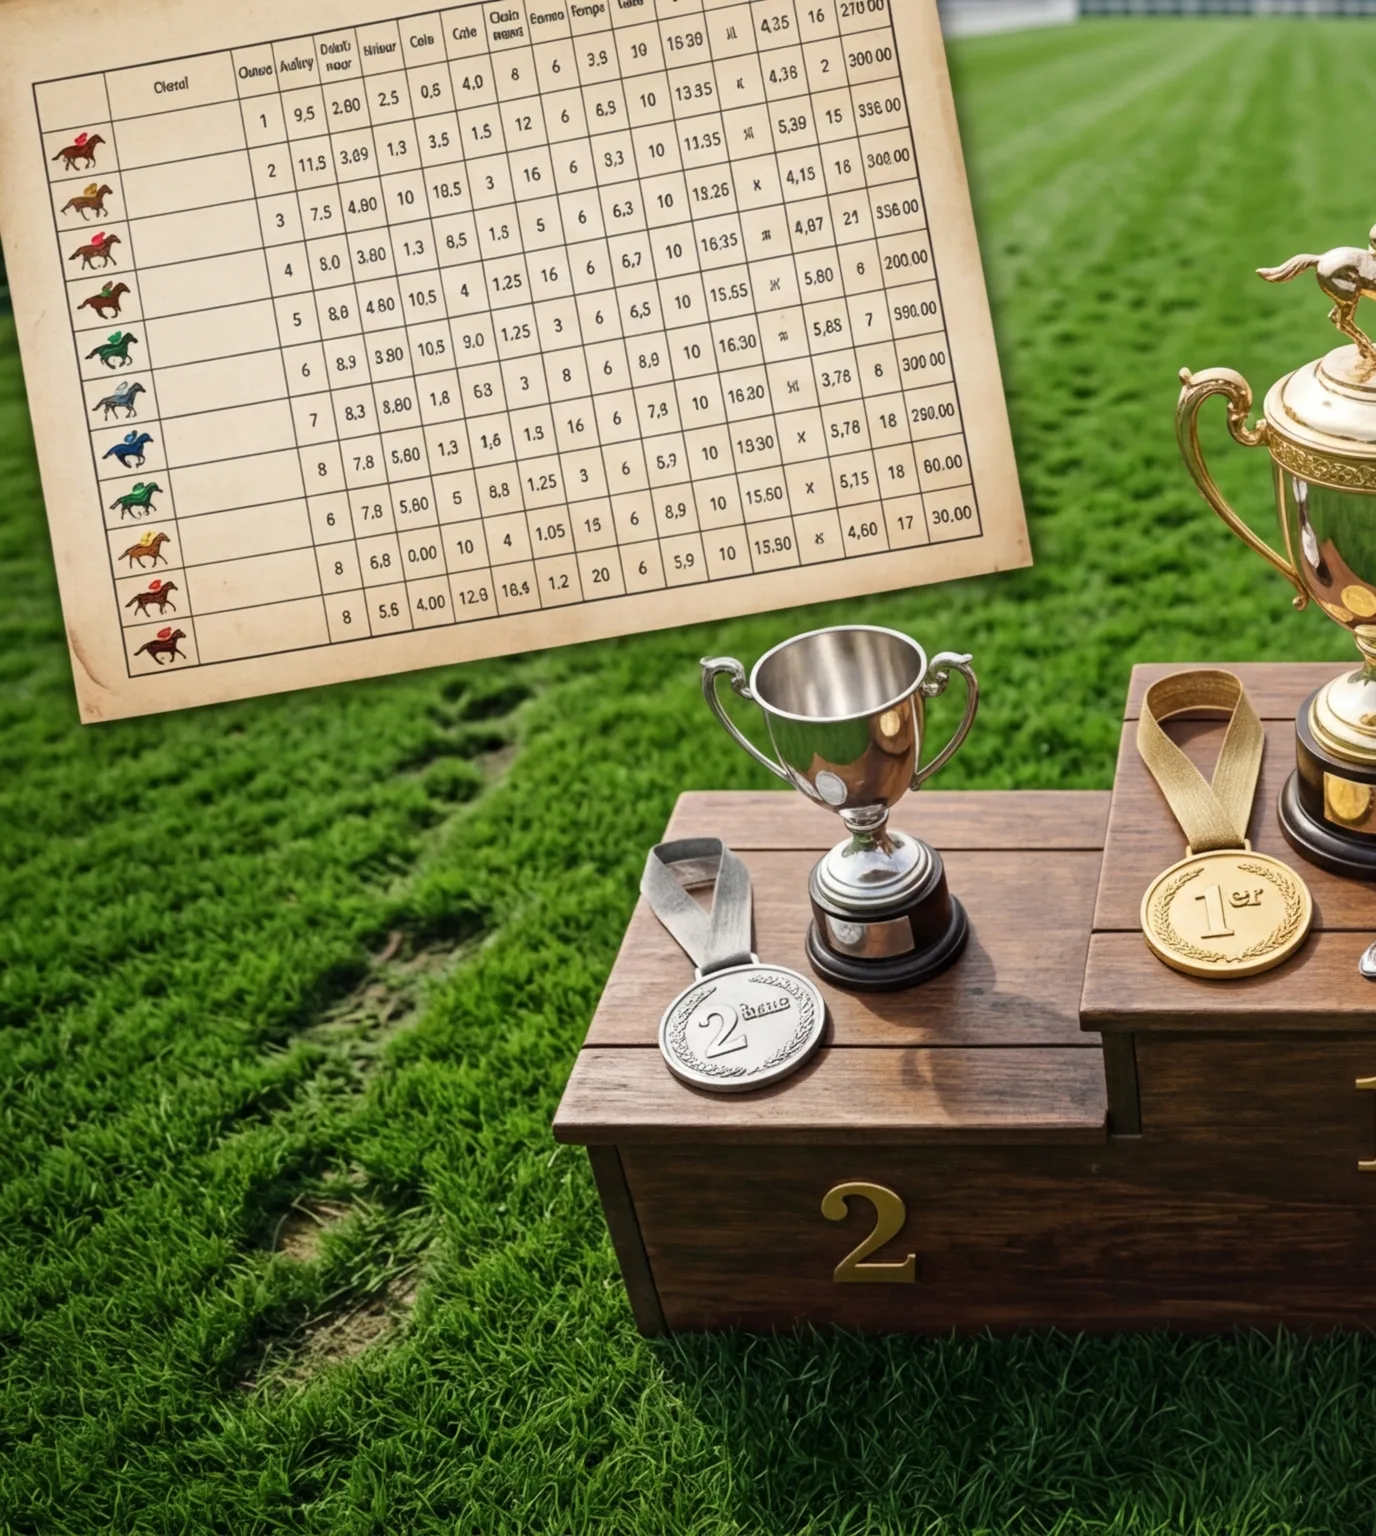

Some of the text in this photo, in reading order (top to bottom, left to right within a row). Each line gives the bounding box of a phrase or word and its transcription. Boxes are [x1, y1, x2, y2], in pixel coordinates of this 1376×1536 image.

[259, 113, 268, 129] 1
[510, 67, 520, 81] 8
[551, 58, 561, 74] 6
[807, 7, 825, 24] 16
[267, 163, 277, 178] 2
[514, 115, 533, 132] 12
[560, 108, 570, 124] 6
[639, 92, 657, 108] 10
[820, 58, 830, 74] 2
[275, 212, 286, 228] 3
[396, 189, 415, 206] 10
[485, 175, 495, 191] 3
[523, 166, 542, 183] 16
[569, 159, 578, 174] 6
[648, 142, 665, 159] 10
[825, 107, 843, 125] 15
[284, 262, 294, 277] 4
[536, 217, 546, 233] 5
[577, 209, 587, 225] 6
[656, 193, 674, 209] 10
[292, 311, 302, 327] 5
[460, 283, 470, 298] 4
[491, 273, 523, 292] 1.25
[540, 266, 559, 283] 16
[586, 259, 596, 276] 6
[665, 243, 683, 260] 10
[301, 362, 311, 378] 6
[500, 323, 531, 342] 1.25
[553, 317, 564, 333] 3
[595, 310, 604, 325] 6
[674, 294, 692, 310] 10
[308, 412, 318, 428] 7
[519, 375, 530, 391] 3
[561, 367, 572, 383] 8
[603, 360, 613, 376] 6
[683, 343, 701, 360] 10
[864, 312, 873, 327] 7
[317, 462, 328, 477] 8
[567, 417, 585, 434] 16
[612, 410, 622, 426] 6
[691, 395, 709, 411] 10
[326, 512, 336, 527] 6
[452, 490, 463, 506] 5
[527, 473, 557, 492] 1.25
[579, 468, 589, 483] 3
[621, 461, 631, 476] 6
[701, 445, 719, 461] 10
[879, 412, 898, 429] 18
[334, 561, 344, 576] 8
[456, 539, 474, 555] 10
[503, 533, 513, 547] 4
[535, 523, 566, 542] 1.05
[629, 510, 640, 526] 6
[709, 495, 727, 512] 10
[342, 609, 352, 625] 8
[548, 574, 570, 590] 1.2
[591, 567, 611, 584] 20
[638, 560, 648, 576] 6
[719, 545, 737, 561] 10
[897, 515, 914, 531] 17
[821, 1181, 916, 1283] 2
